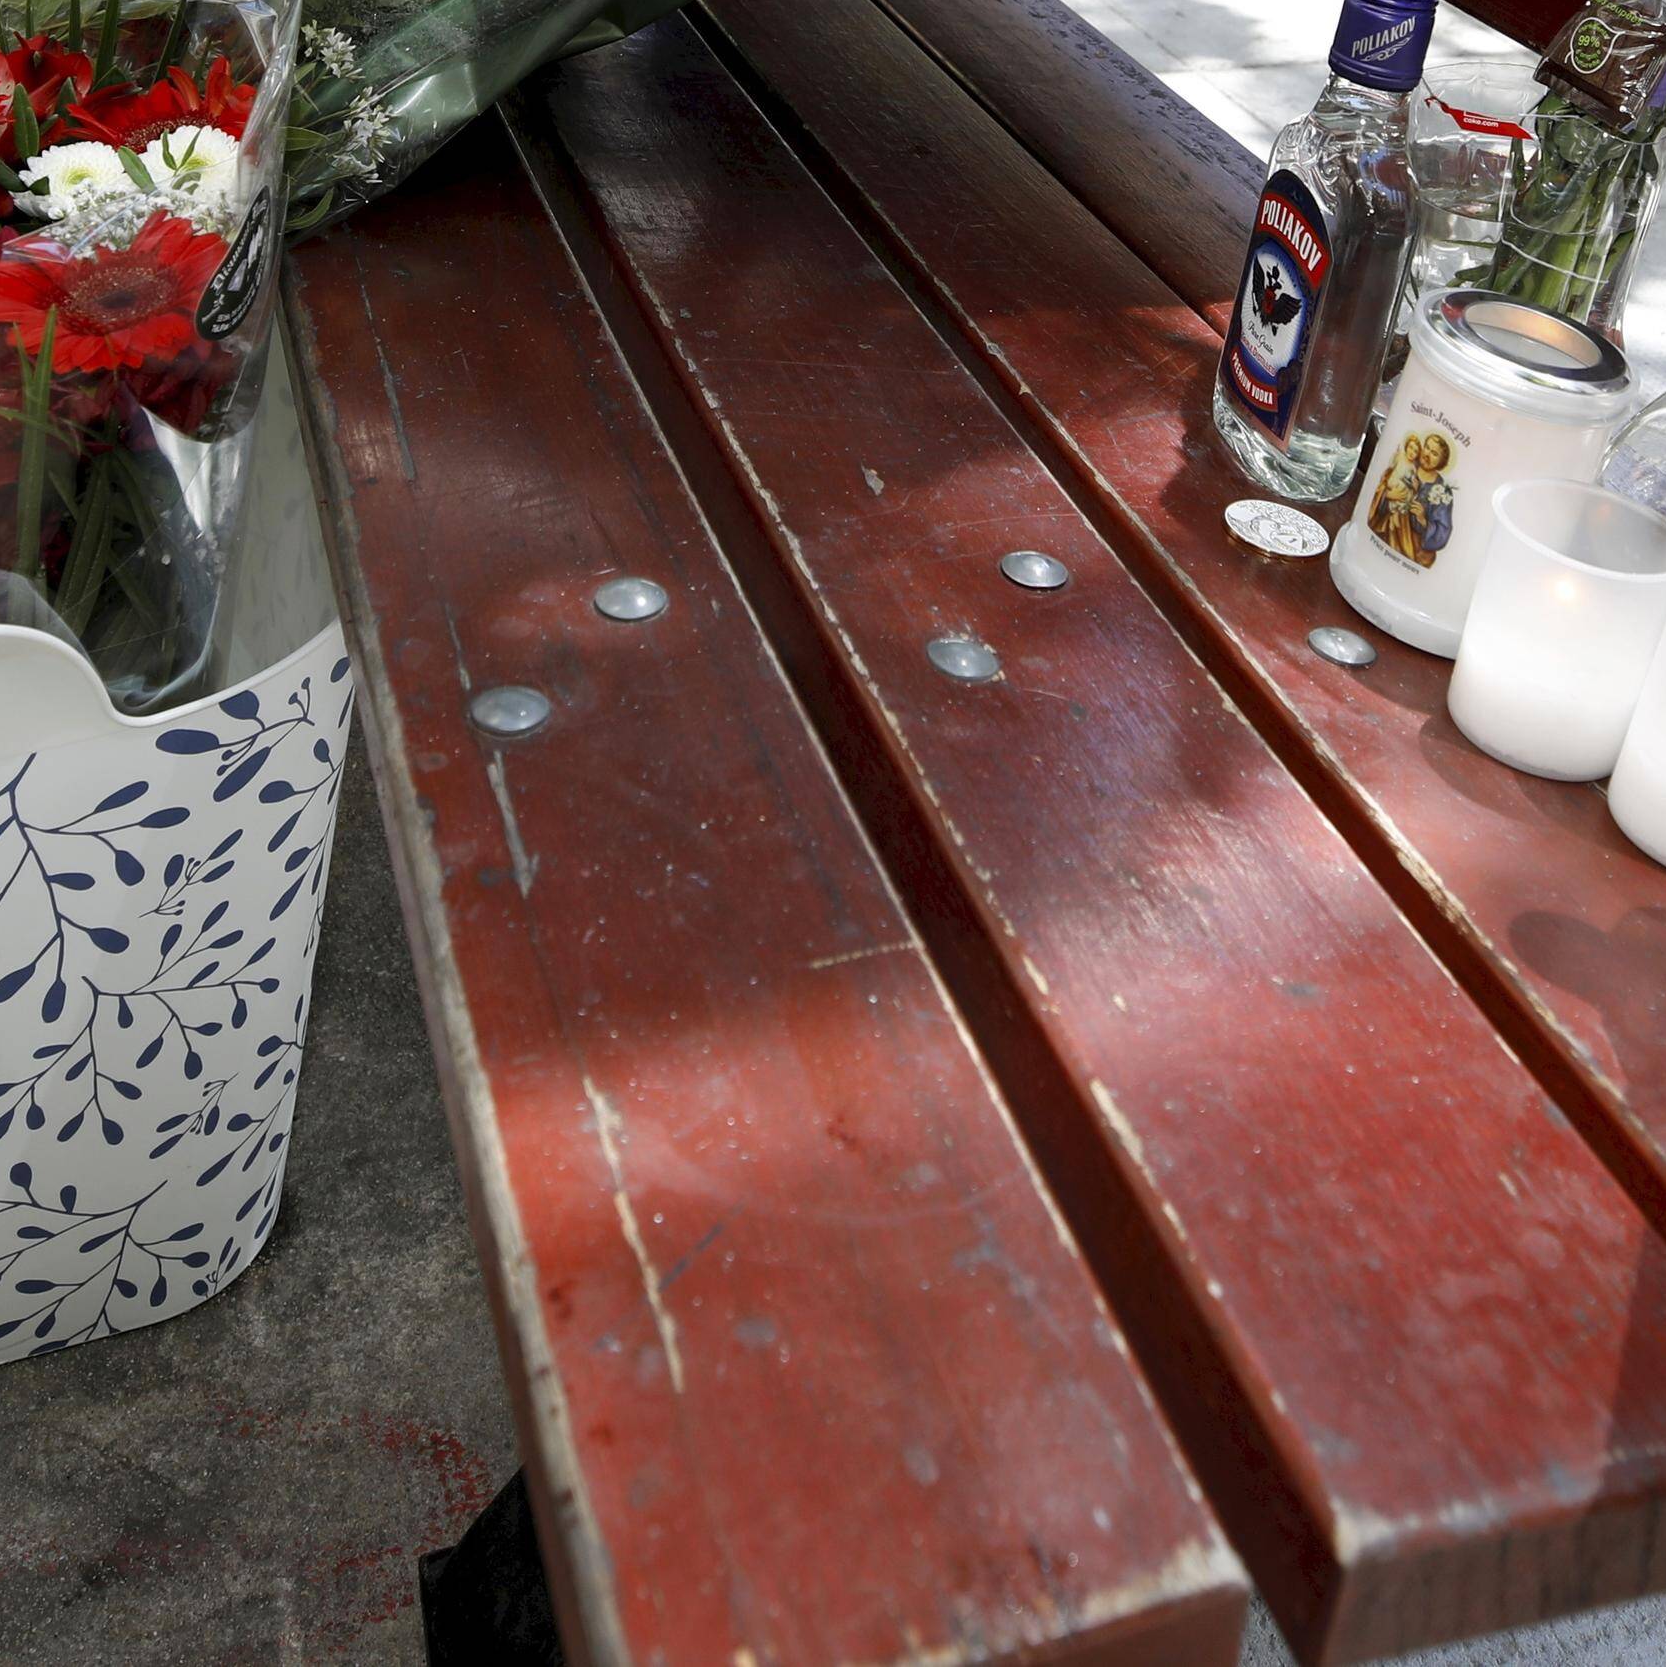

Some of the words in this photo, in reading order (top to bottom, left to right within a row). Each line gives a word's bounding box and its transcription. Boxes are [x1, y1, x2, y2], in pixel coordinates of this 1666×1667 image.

[1351, 15, 1417, 59] POLIAKOV
[1577, 34, 1602, 49] 99%
[1462, 116, 1500, 129] coke.com
[1260, 198, 1324, 272] POLIAKOV
[1232, 352, 1252, 394] PREMIUM
[1250, 382, 1274, 406] VODKA
[1409, 399, 1472, 449] Saint-Joseph
